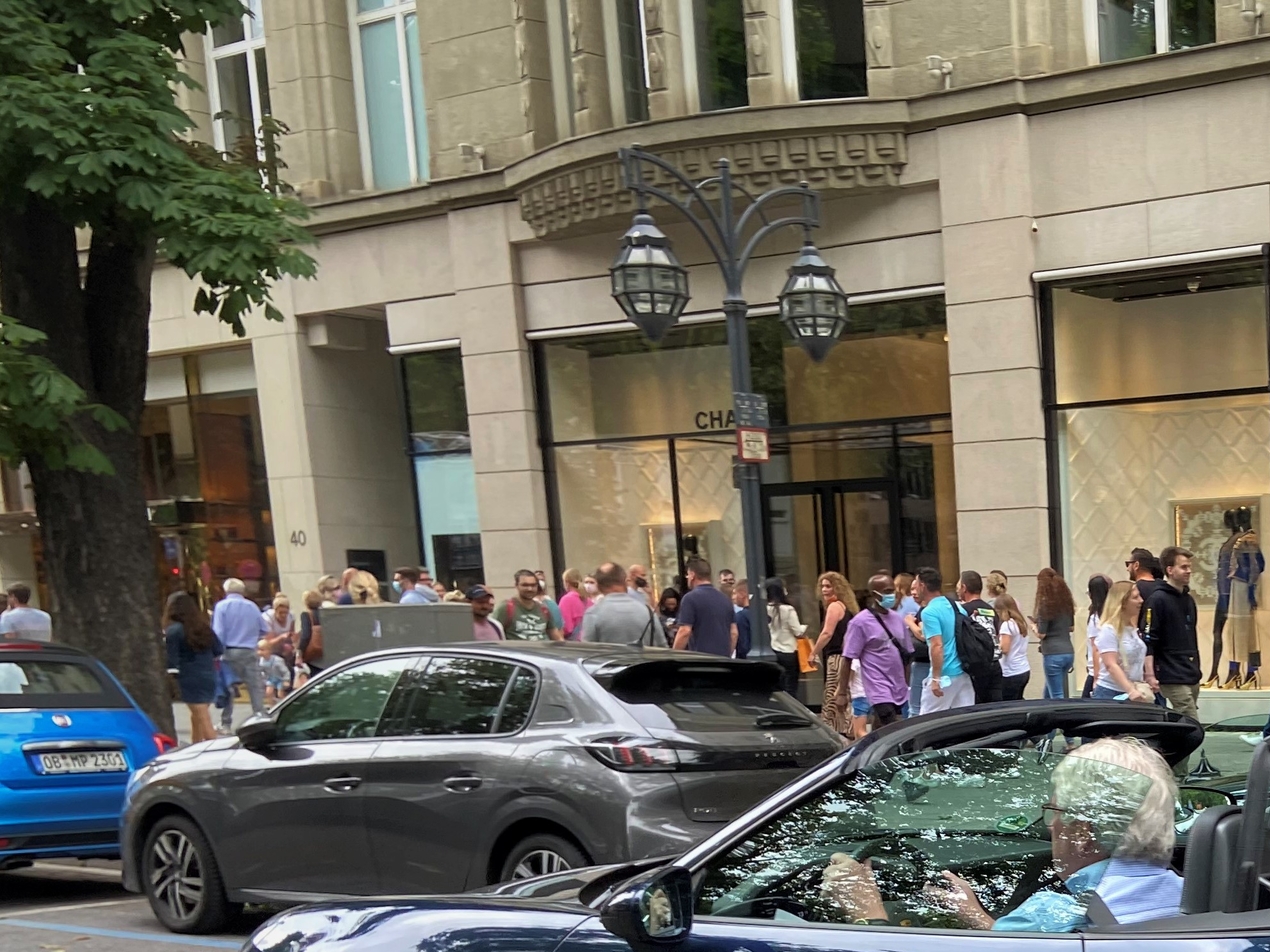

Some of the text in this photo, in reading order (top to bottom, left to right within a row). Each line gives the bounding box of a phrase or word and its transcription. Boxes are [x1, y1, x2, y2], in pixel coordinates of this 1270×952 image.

[290, 529, 307, 547] 40
[43, 754, 62, 769] OB
[69, 753, 88, 768] MP
